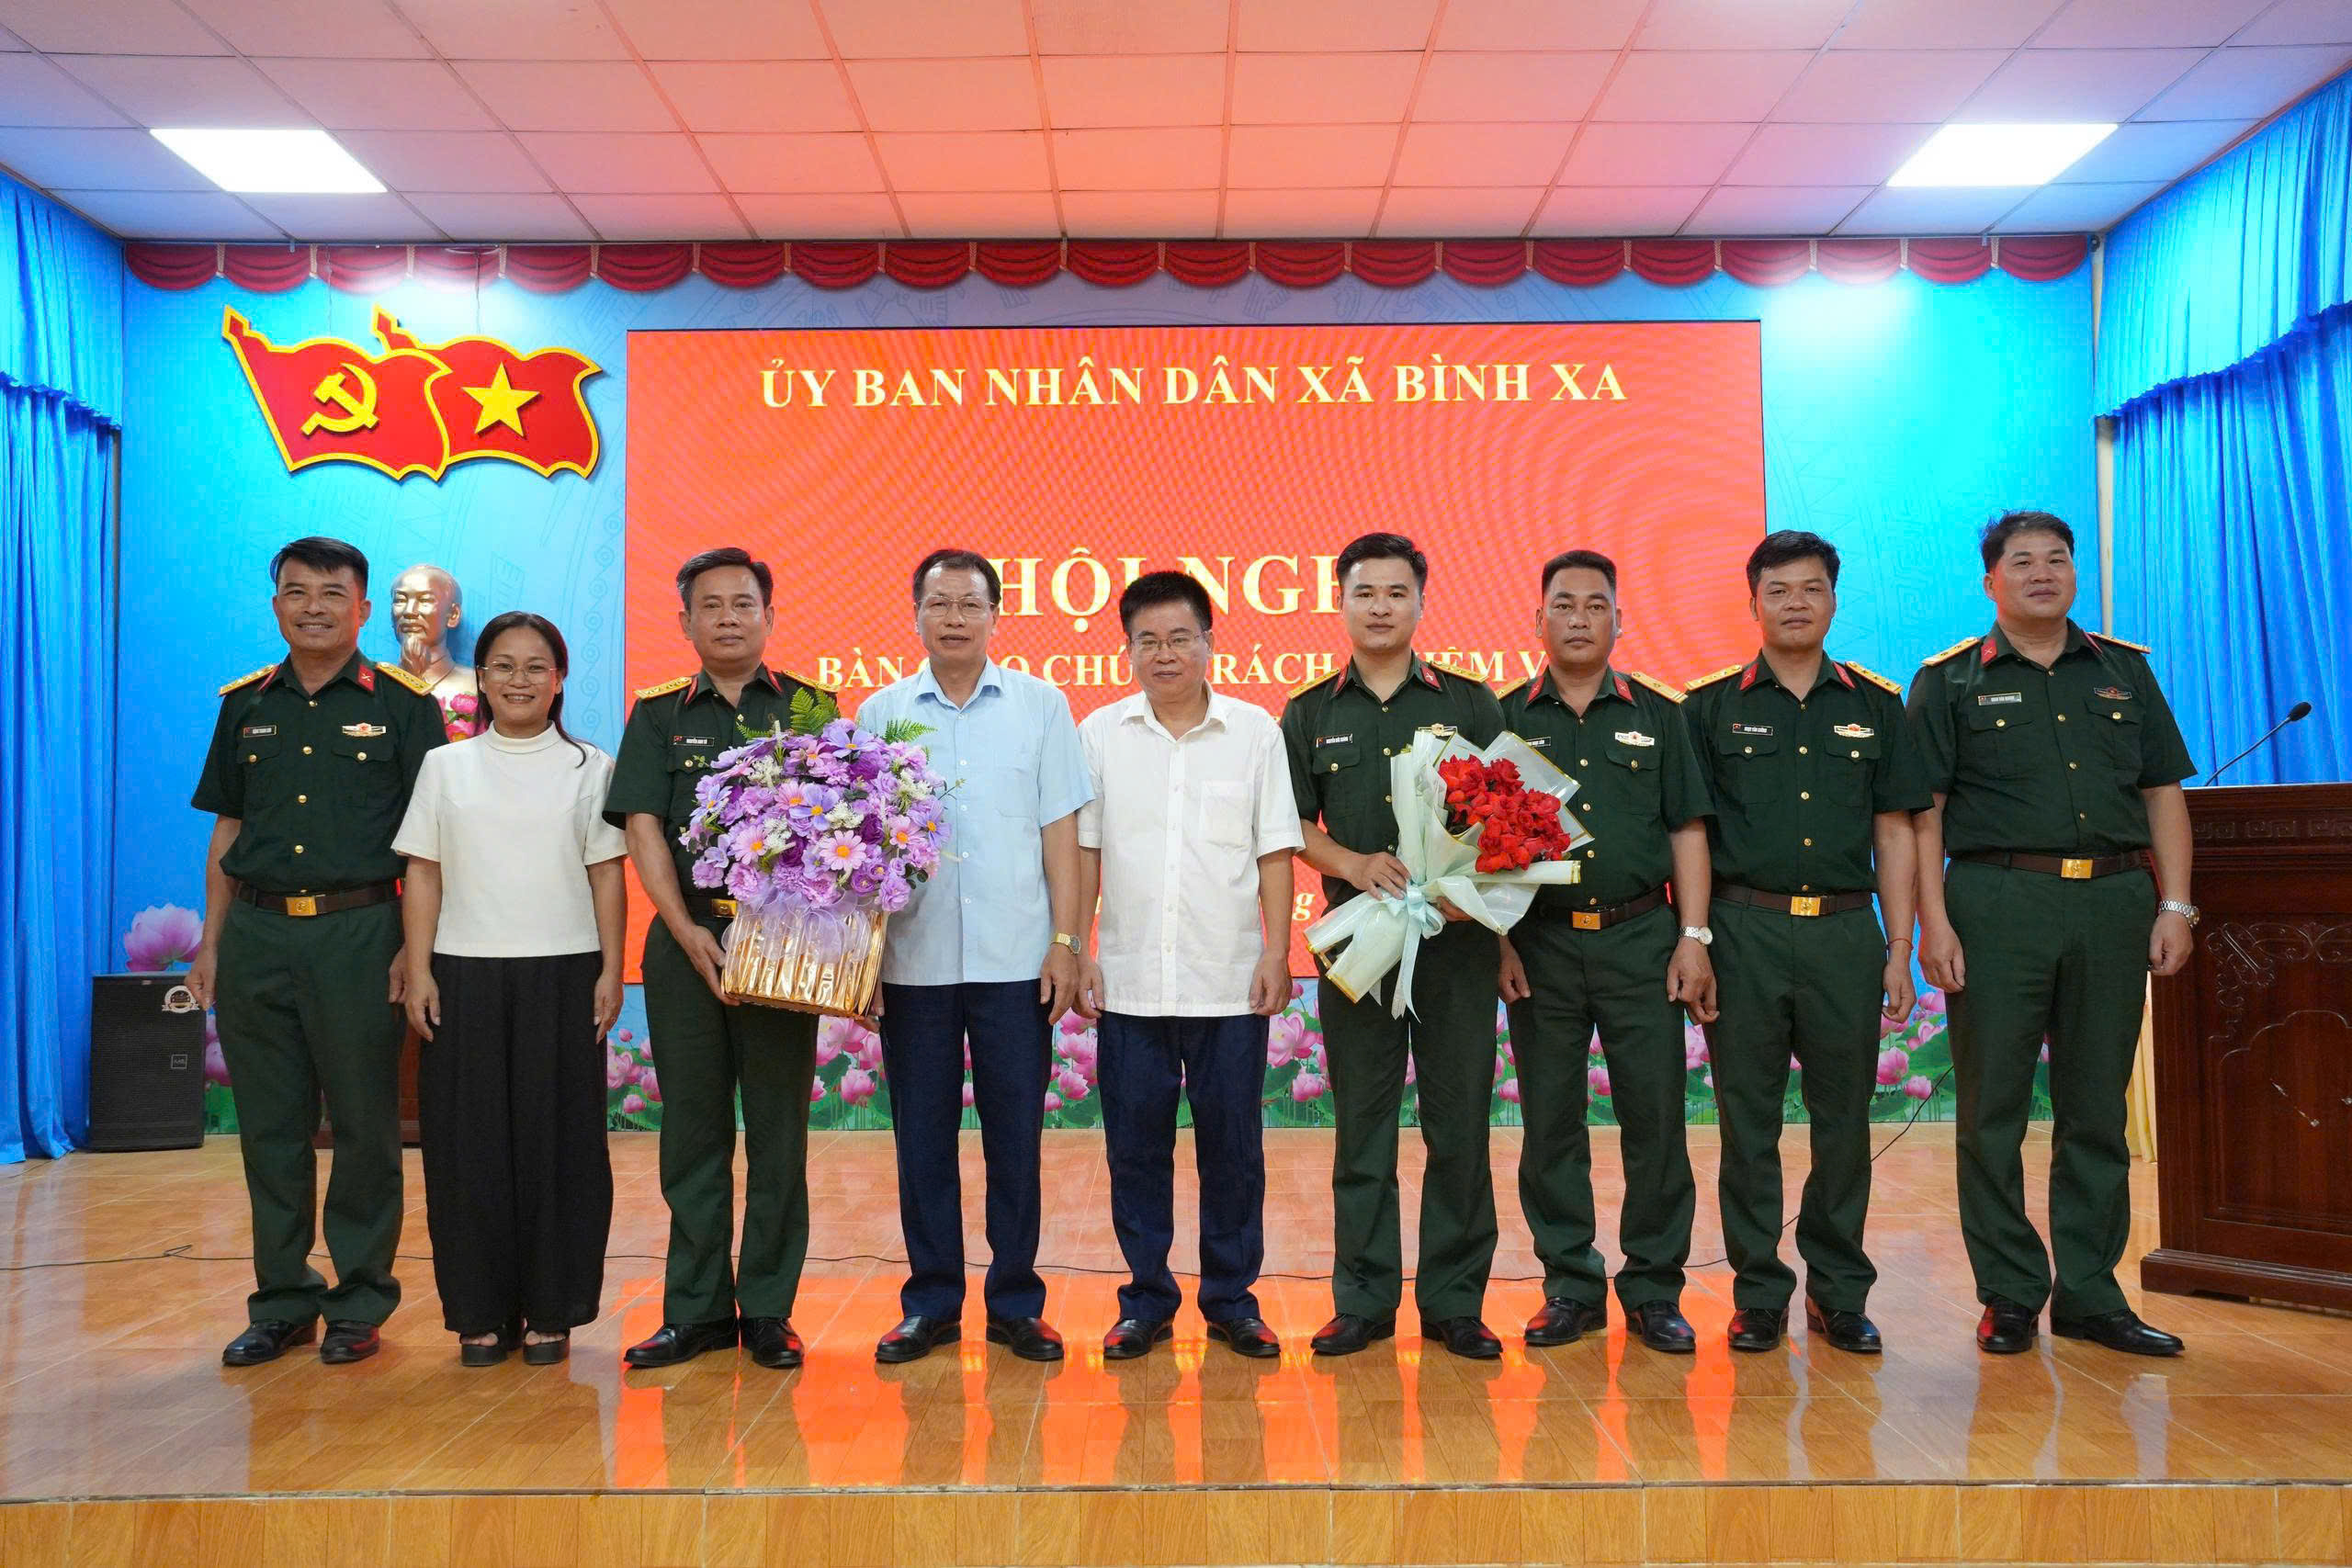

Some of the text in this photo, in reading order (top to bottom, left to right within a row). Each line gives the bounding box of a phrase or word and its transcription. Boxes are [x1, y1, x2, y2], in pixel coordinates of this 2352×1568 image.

[761, 353, 1628, 408] ỦY BAN NHÂN DÂN XÃ BÌNH XA
[817, 647, 904, 689] BÀN
[1209, 643, 1339, 684] RÁCH
